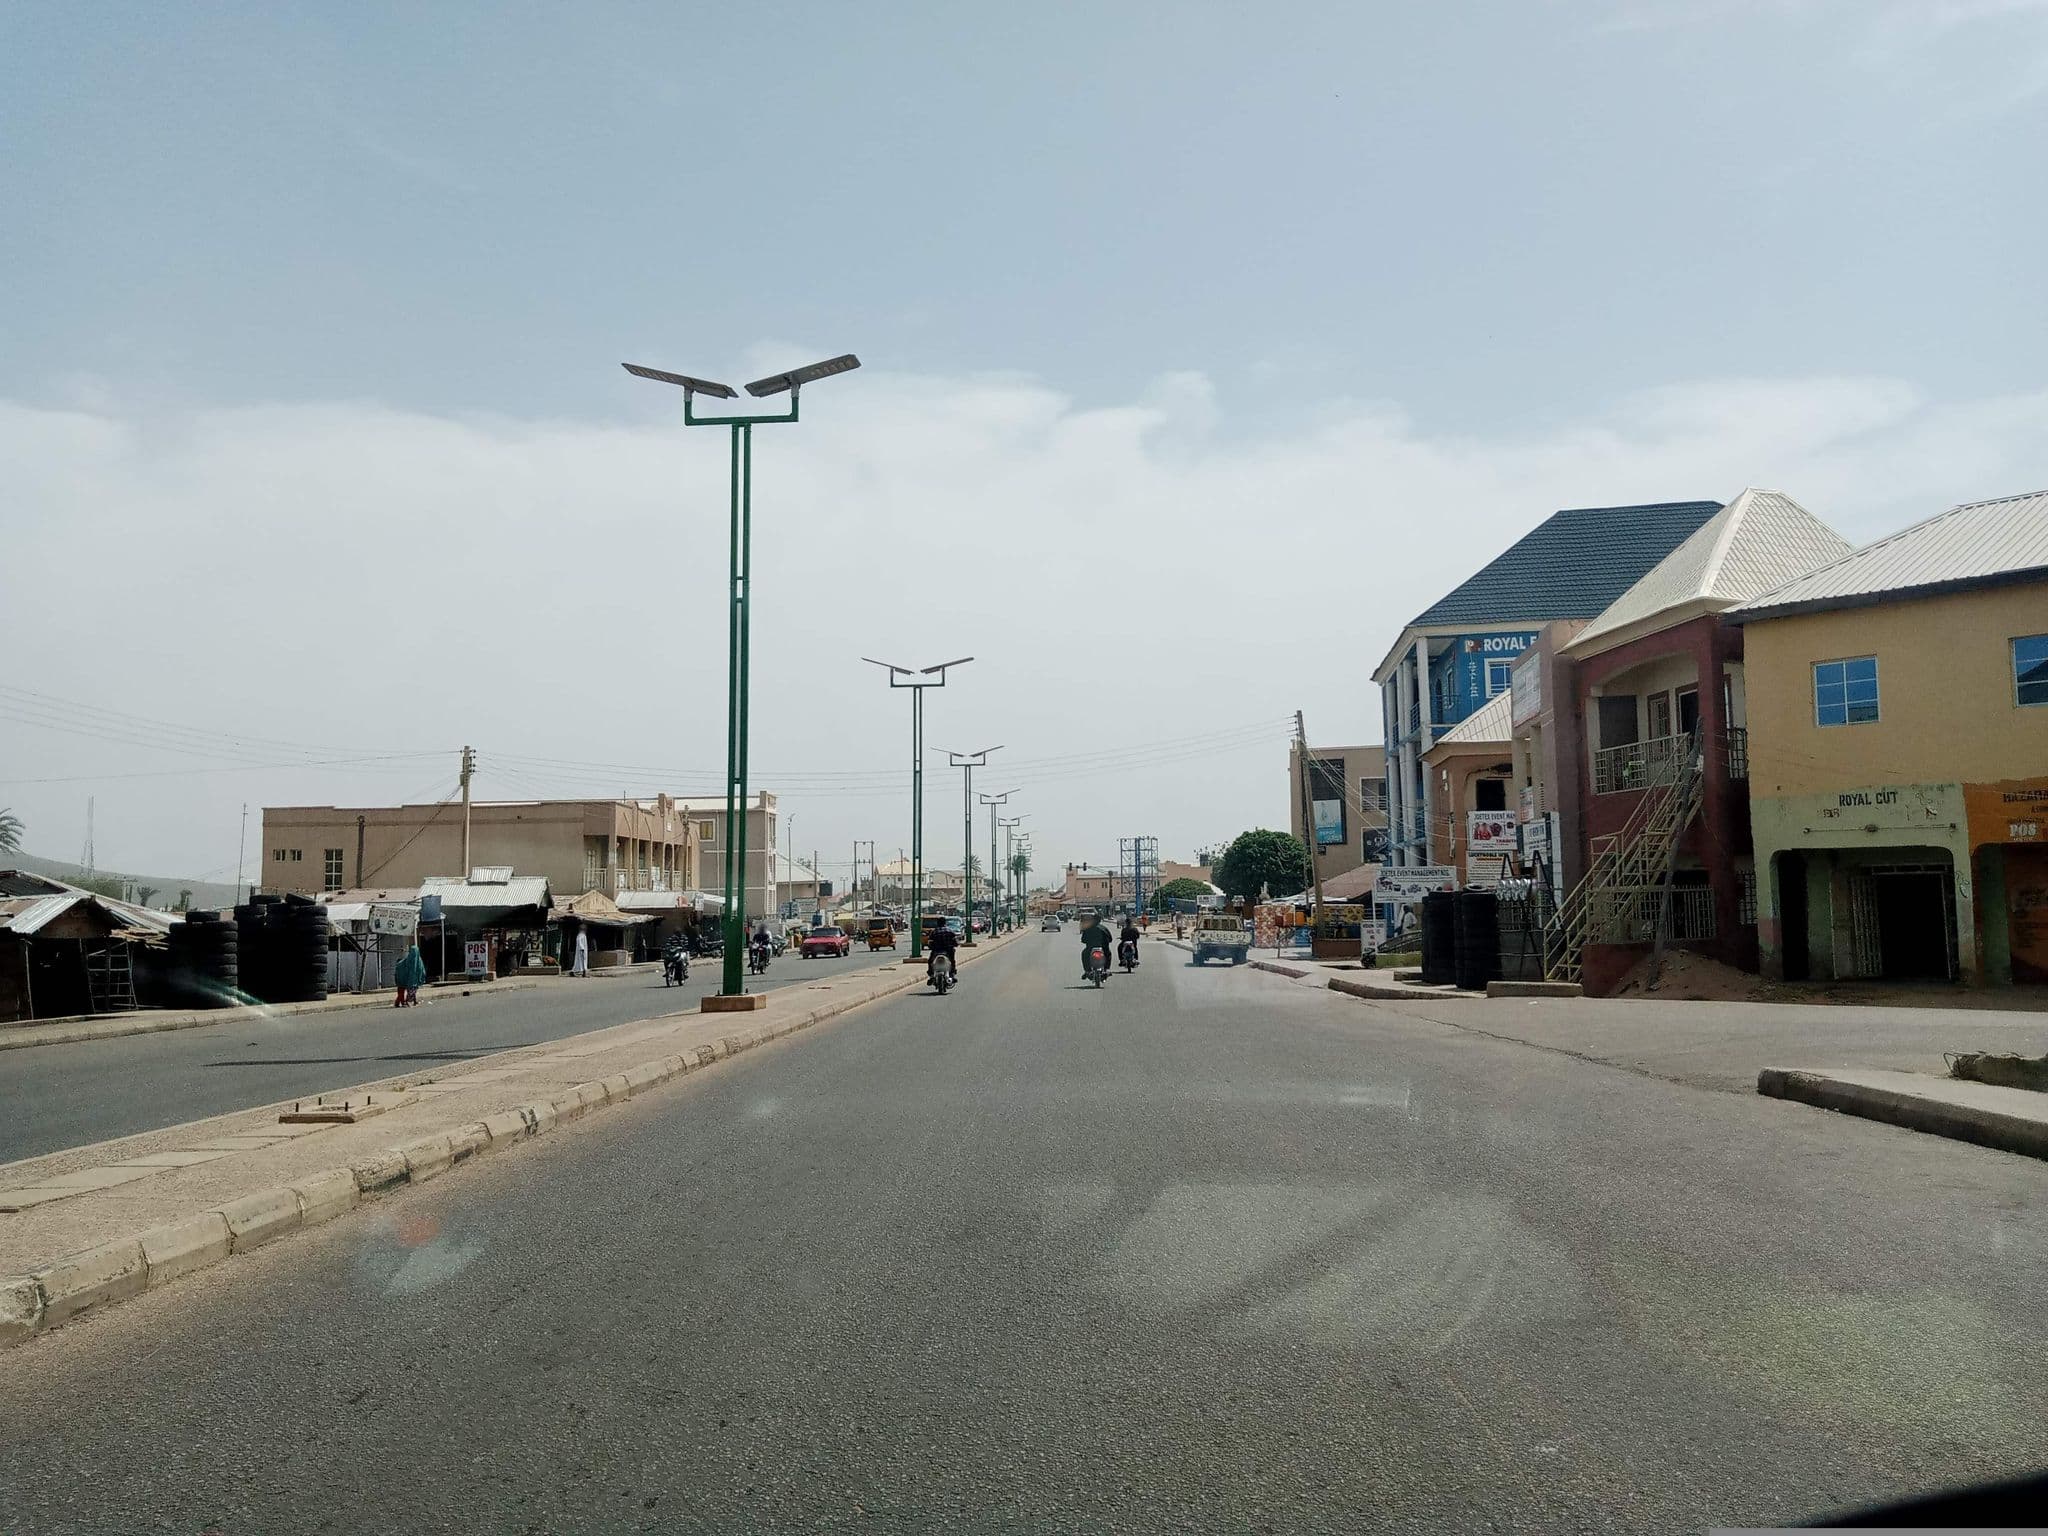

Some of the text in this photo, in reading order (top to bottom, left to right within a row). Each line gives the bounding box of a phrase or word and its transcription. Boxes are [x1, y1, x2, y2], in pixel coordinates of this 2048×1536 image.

[1483, 636, 1526, 651] ROYAL
[1839, 791, 1898, 806] ROYAL CUT
[2010, 822, 2037, 837] POS
[467, 943, 486, 954] POS
